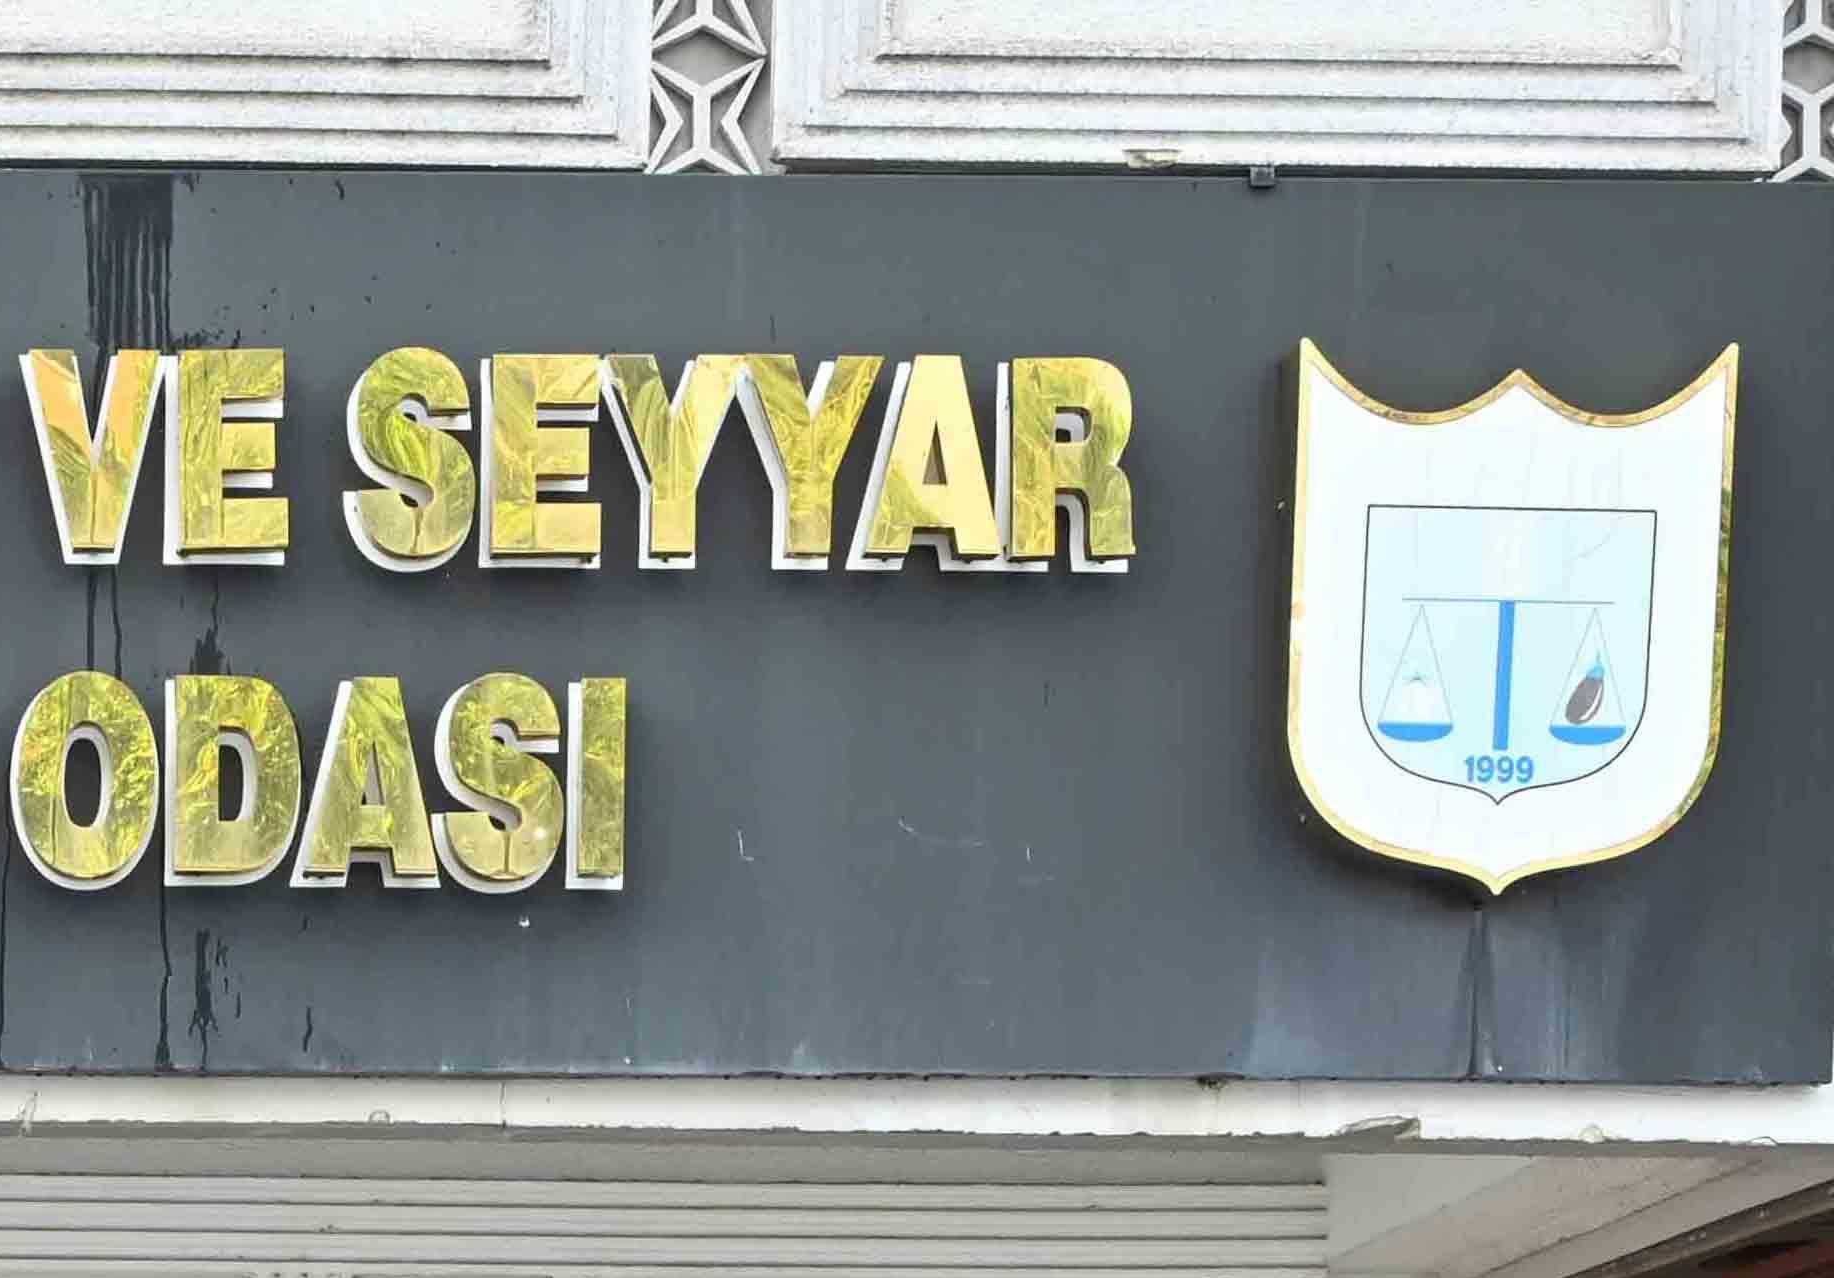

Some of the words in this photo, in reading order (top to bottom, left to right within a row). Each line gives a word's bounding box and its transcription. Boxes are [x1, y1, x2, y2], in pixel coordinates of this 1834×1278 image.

[18, 347, 289, 566] VE
[343, 346, 1136, 574] SEYYAR
[10, 671, 627, 895] ODASI
[1464, 755, 1535, 784] 1999
